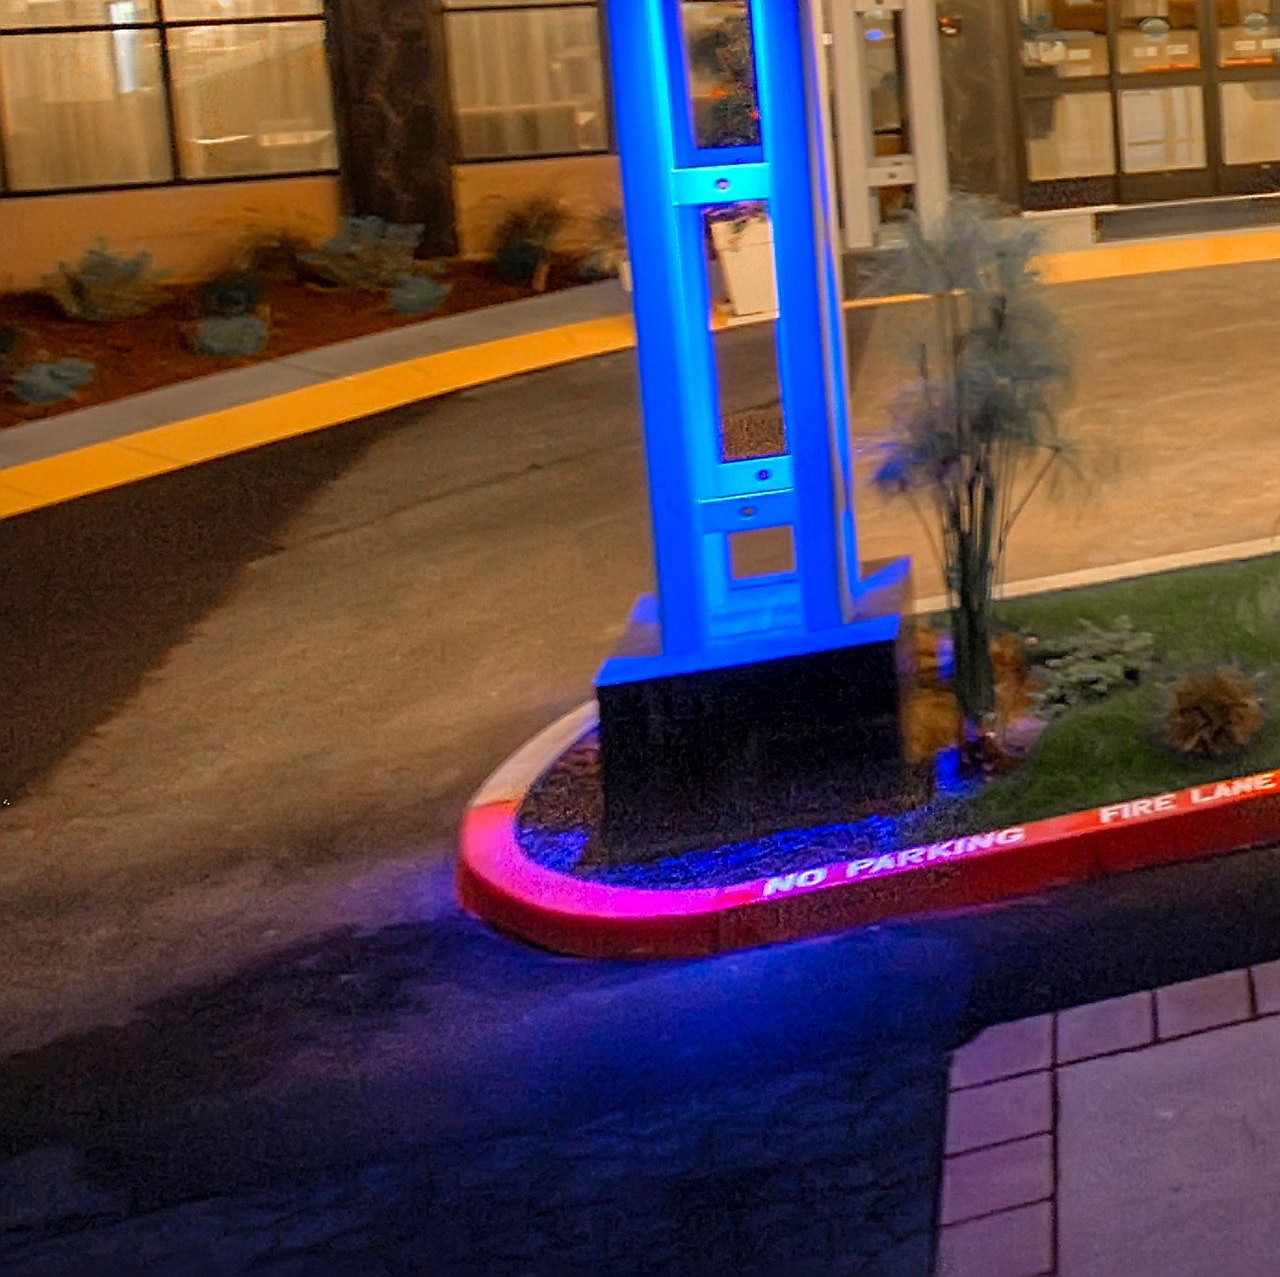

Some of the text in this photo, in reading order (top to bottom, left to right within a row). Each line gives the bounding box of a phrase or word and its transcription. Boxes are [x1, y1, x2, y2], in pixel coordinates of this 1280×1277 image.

[1099, 772, 1277, 824] FIRE LANE
[763, 827, 1026, 895] NO PARKING
